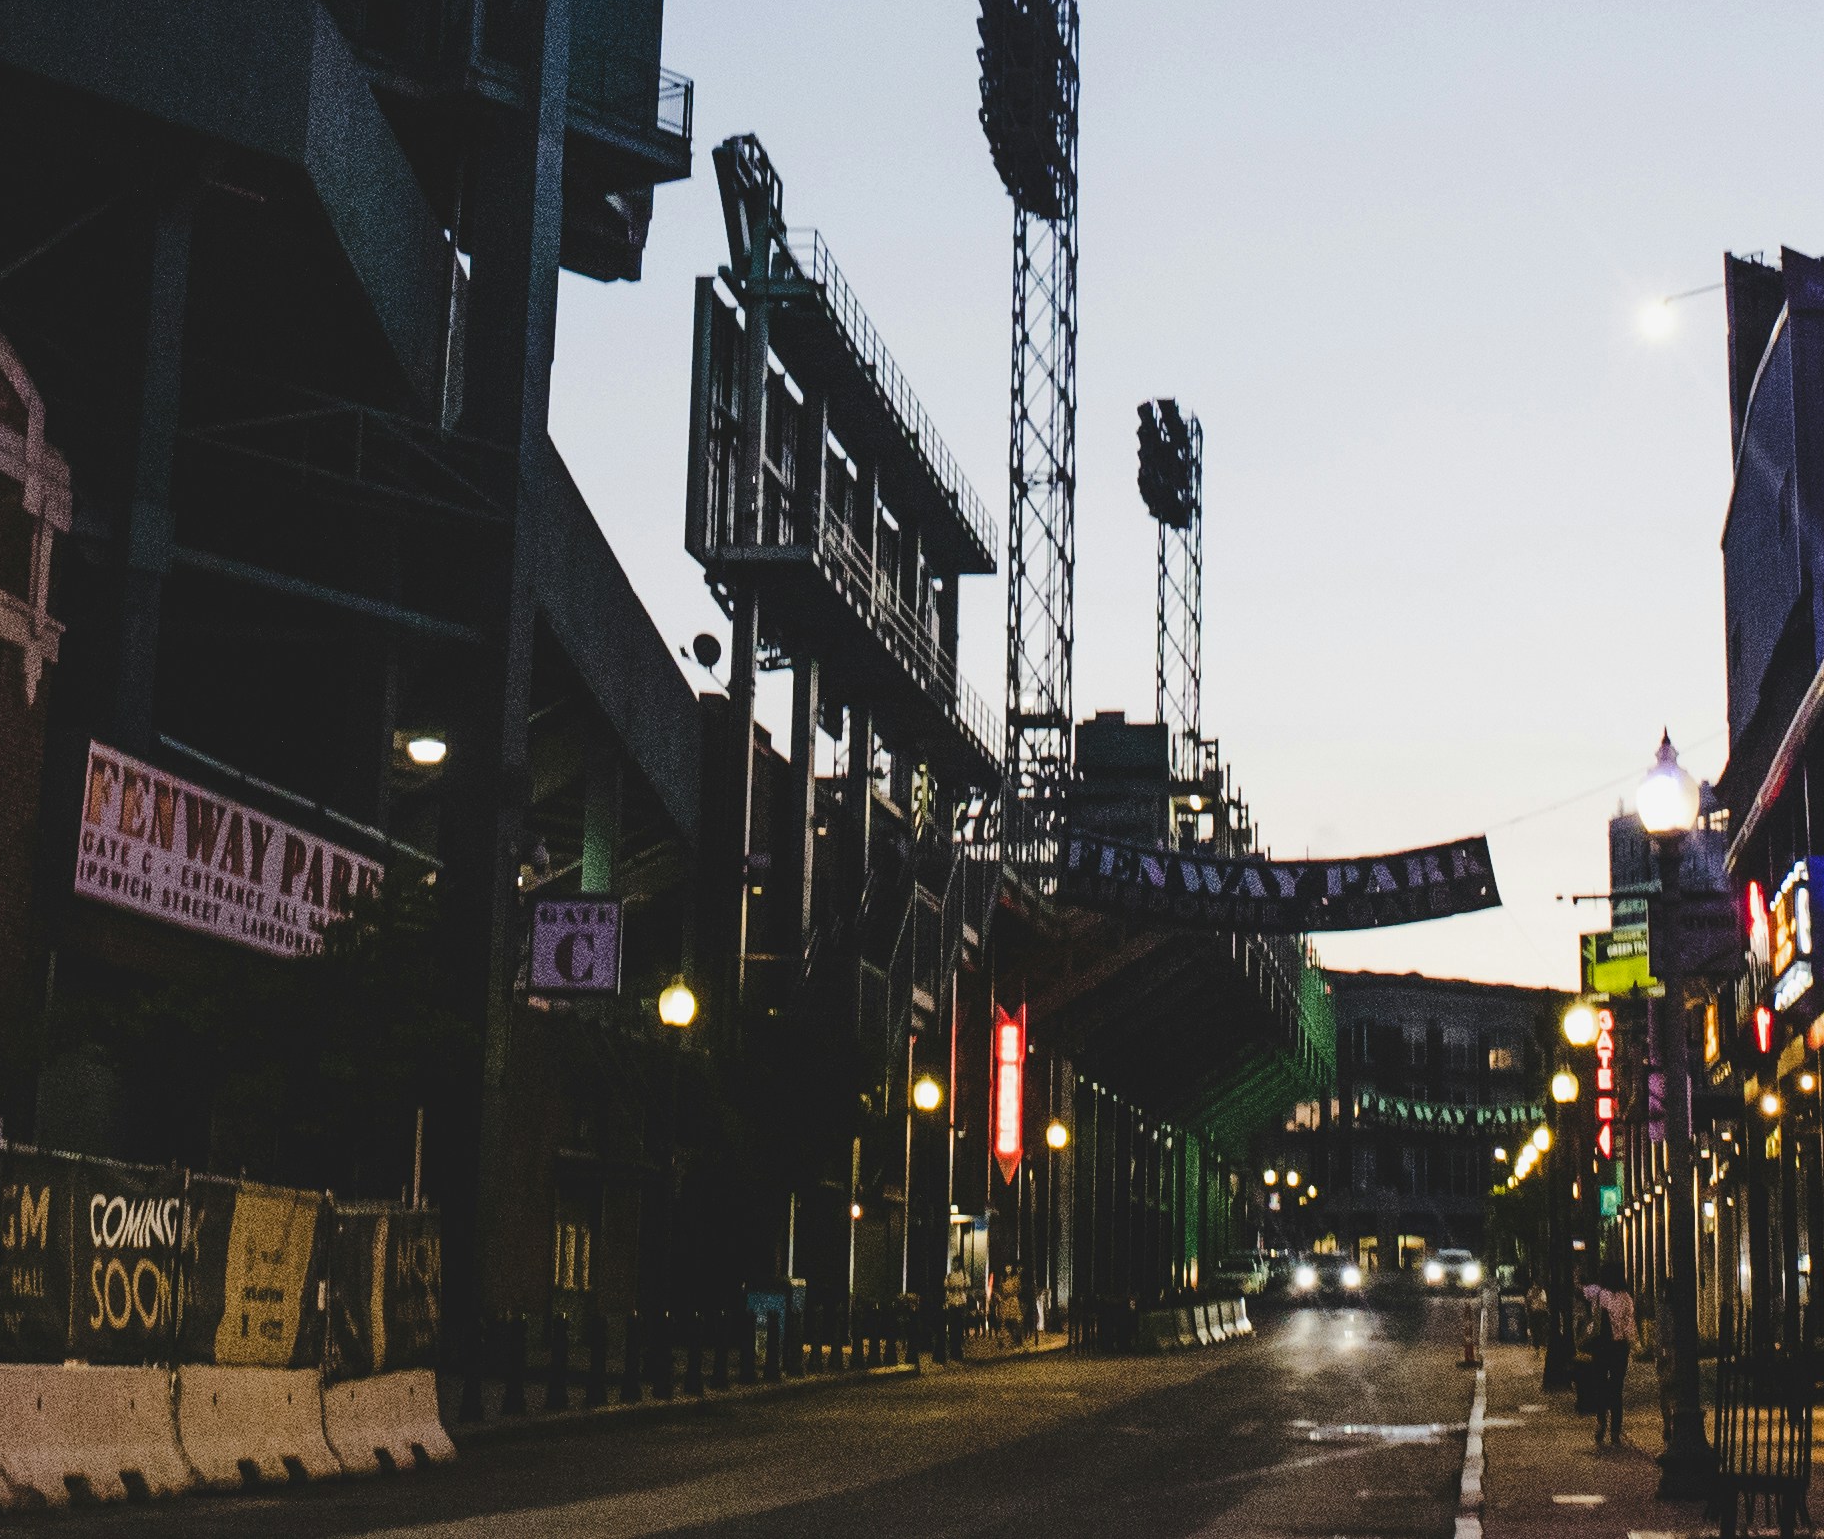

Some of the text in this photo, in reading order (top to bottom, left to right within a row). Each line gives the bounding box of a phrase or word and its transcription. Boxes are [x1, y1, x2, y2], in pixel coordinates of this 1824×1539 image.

[85, 752, 275, 885] FENWAY
[78, 859, 153, 902] IPSWICH
[161, 888, 222, 924] STREET
[81, 830, 131, 868] GATE
[141, 850, 153, 875] C
[180, 865, 266, 914] ENTRANCE
[272, 899, 300, 927] ALL
[1065, 838, 1488, 900] FENWAY PARK
[554, 932, 595, 982] C
